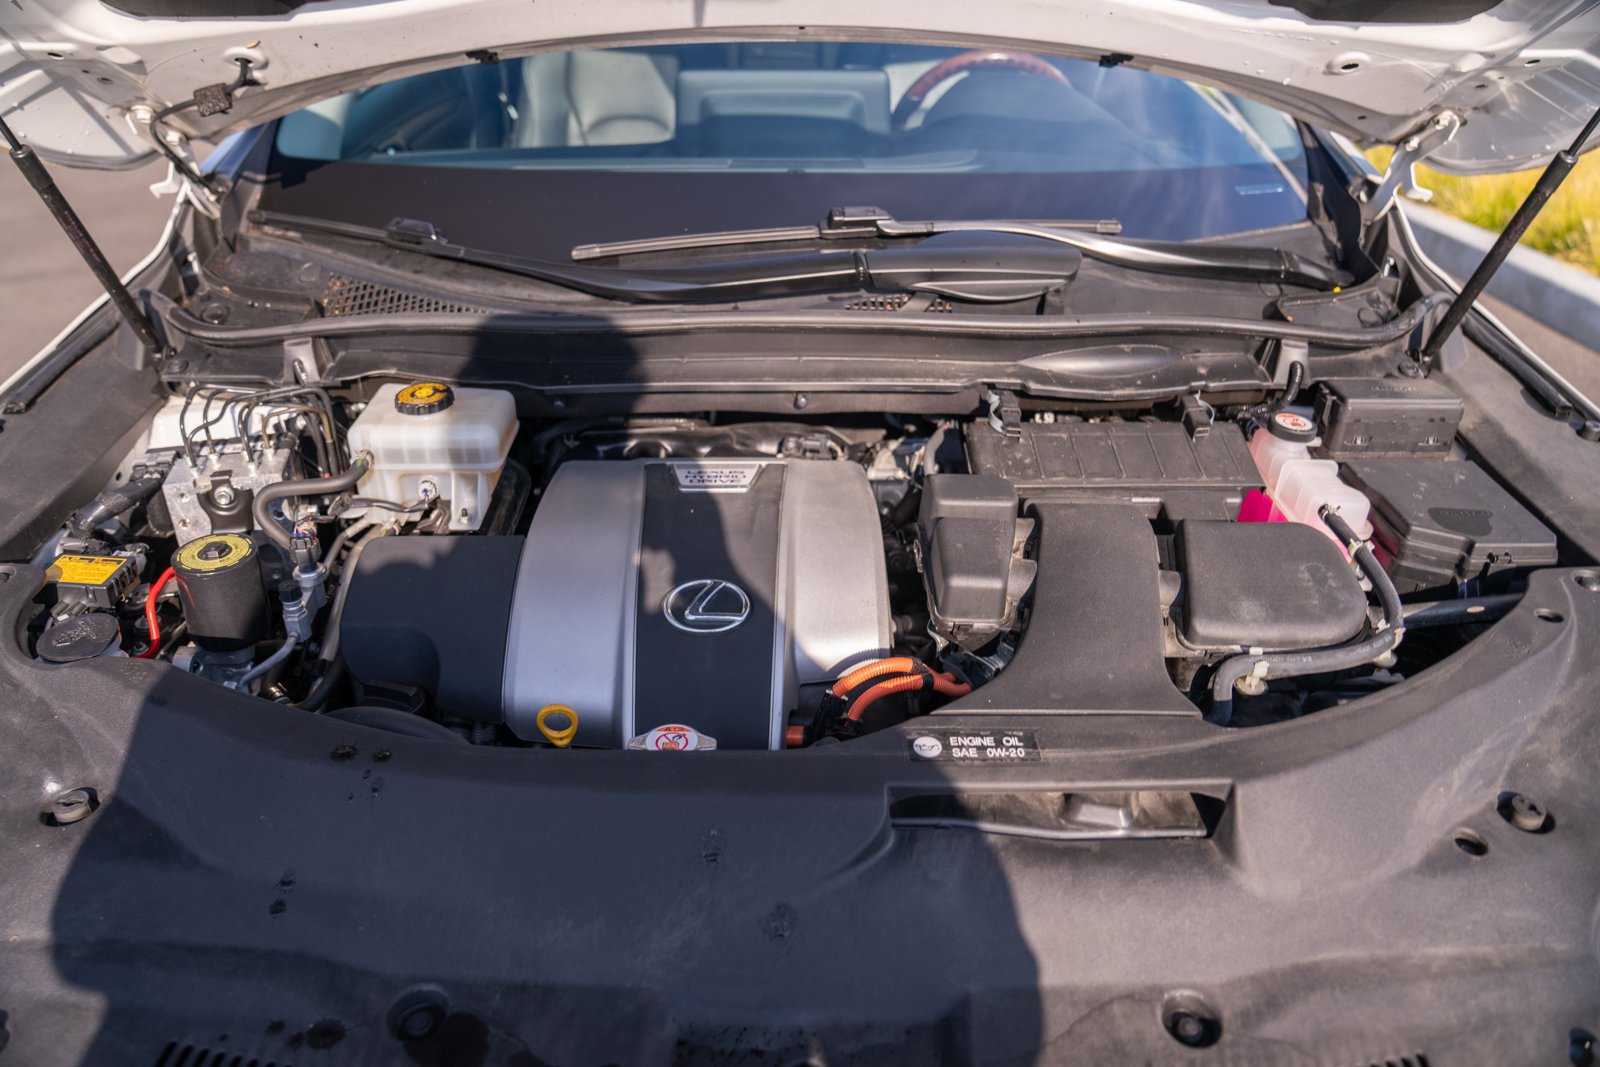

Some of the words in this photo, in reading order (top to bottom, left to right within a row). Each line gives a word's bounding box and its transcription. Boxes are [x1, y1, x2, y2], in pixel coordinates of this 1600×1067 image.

[949, 736, 996, 747] ENGINE
[1002, 736, 1024, 747] OIL
[951, 747, 978, 758] SAE
[986, 747, 1025, 758] 0W-20
